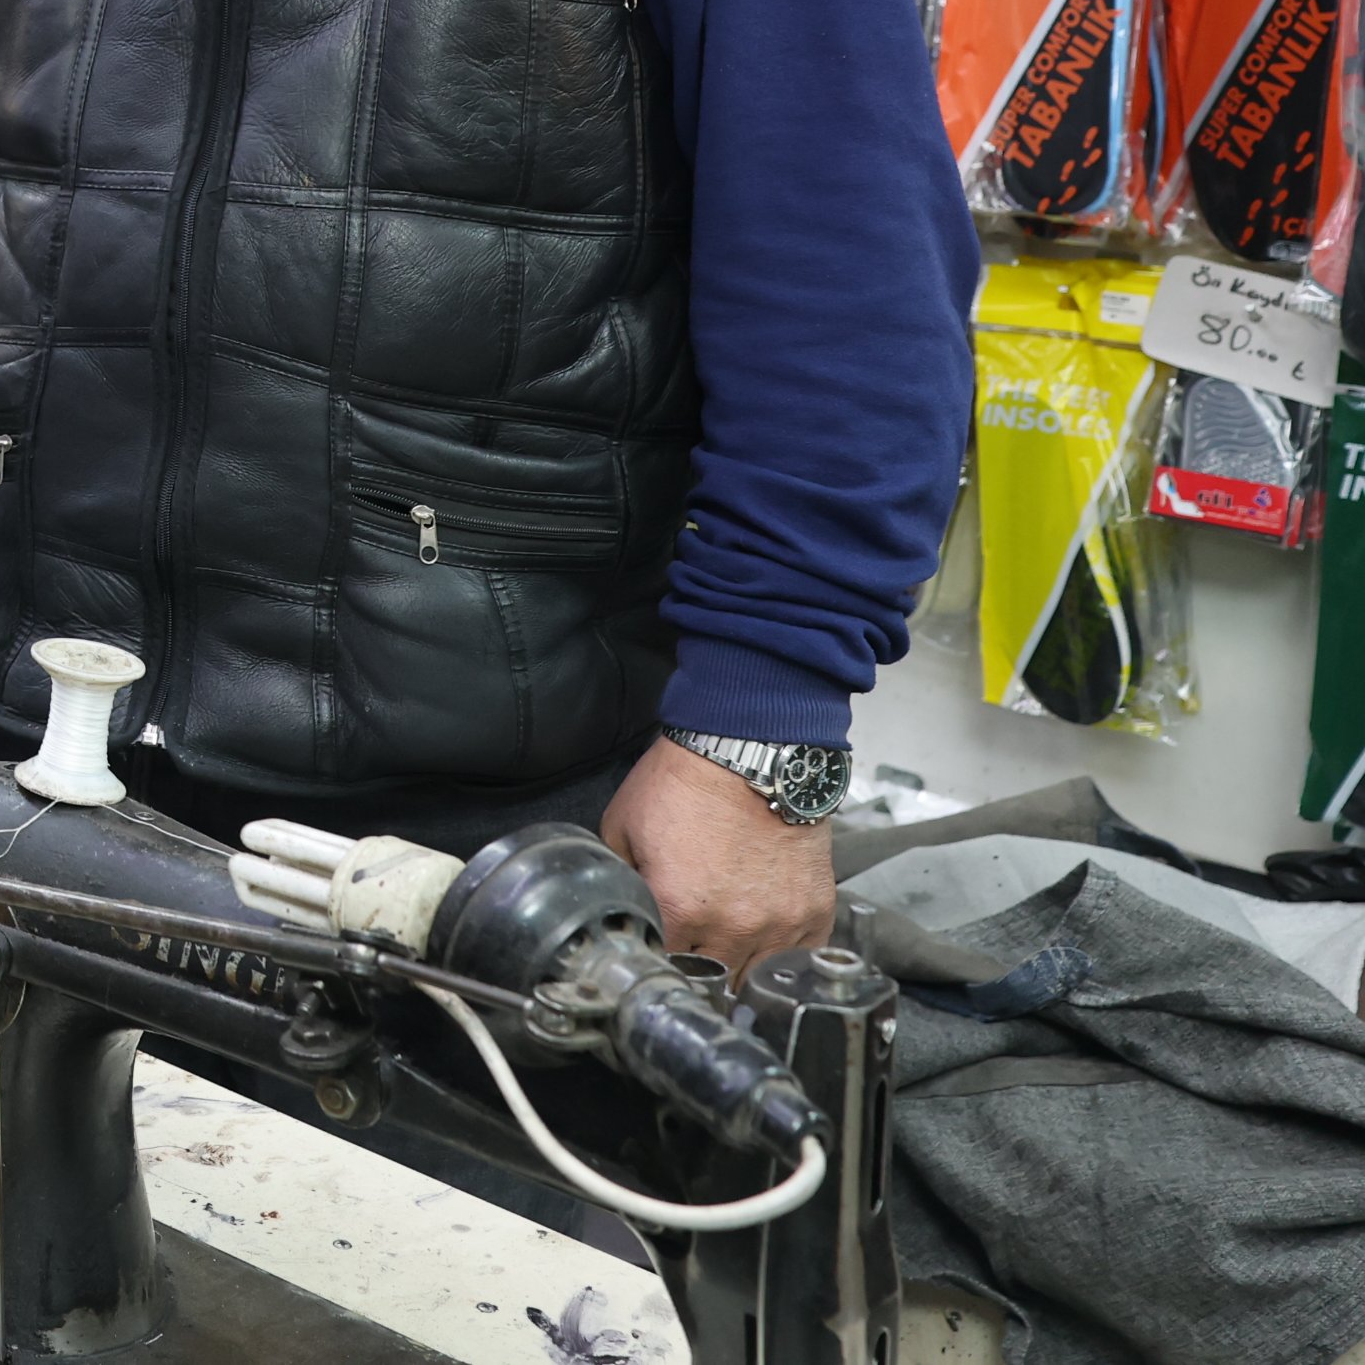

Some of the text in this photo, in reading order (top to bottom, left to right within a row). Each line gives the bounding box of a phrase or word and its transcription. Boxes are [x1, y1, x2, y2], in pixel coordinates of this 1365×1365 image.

[988, 85, 1037, 152] SUPER
[1198, 86, 1247, 152] SUPER
[985, 374, 1043, 403] THE
[982, 403, 1112, 441] INSOLES
